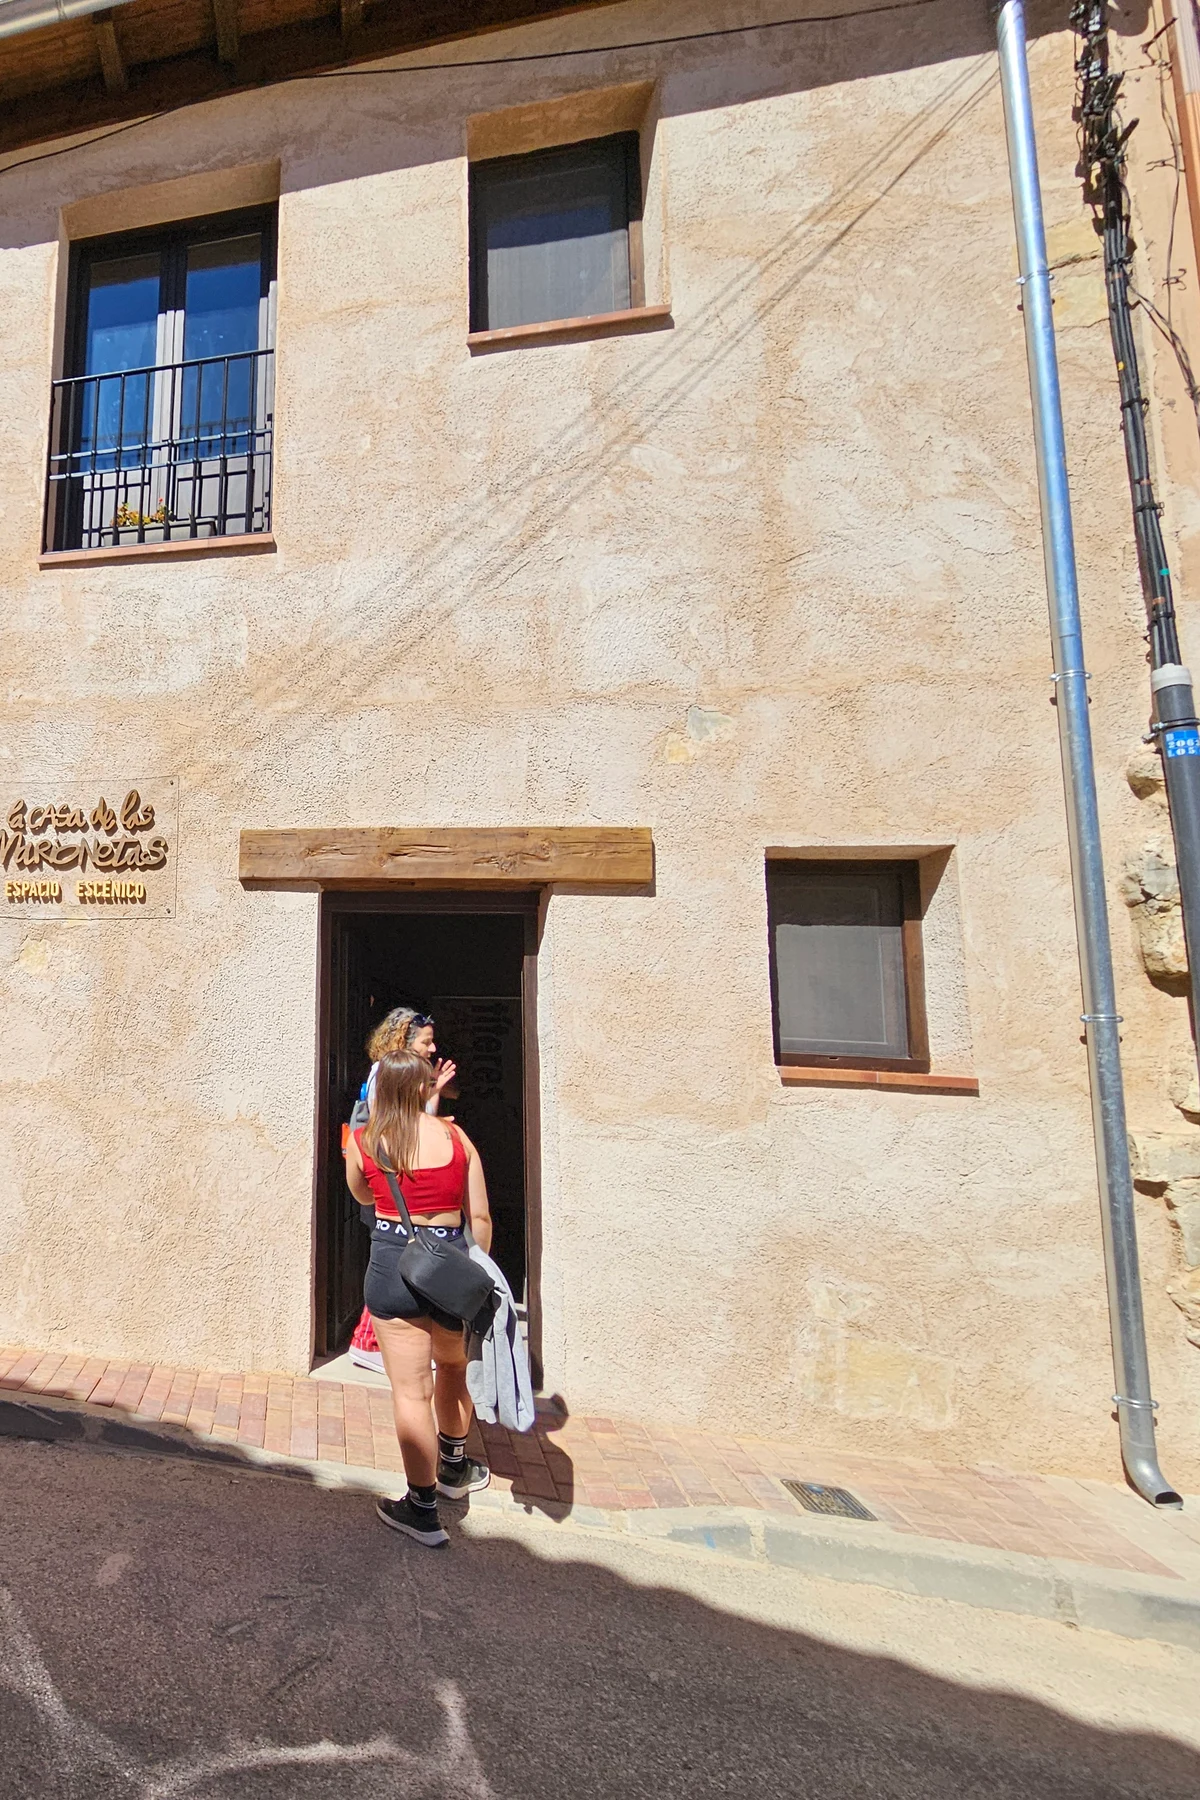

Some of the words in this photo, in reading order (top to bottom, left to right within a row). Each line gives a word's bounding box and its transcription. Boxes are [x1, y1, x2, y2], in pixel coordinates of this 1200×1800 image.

[90, 796, 116, 830] de
[120, 789, 154, 829] las
[5, 880, 60, 897] ESPACIO
[76, 878, 144, 899] ESCÉNICO
